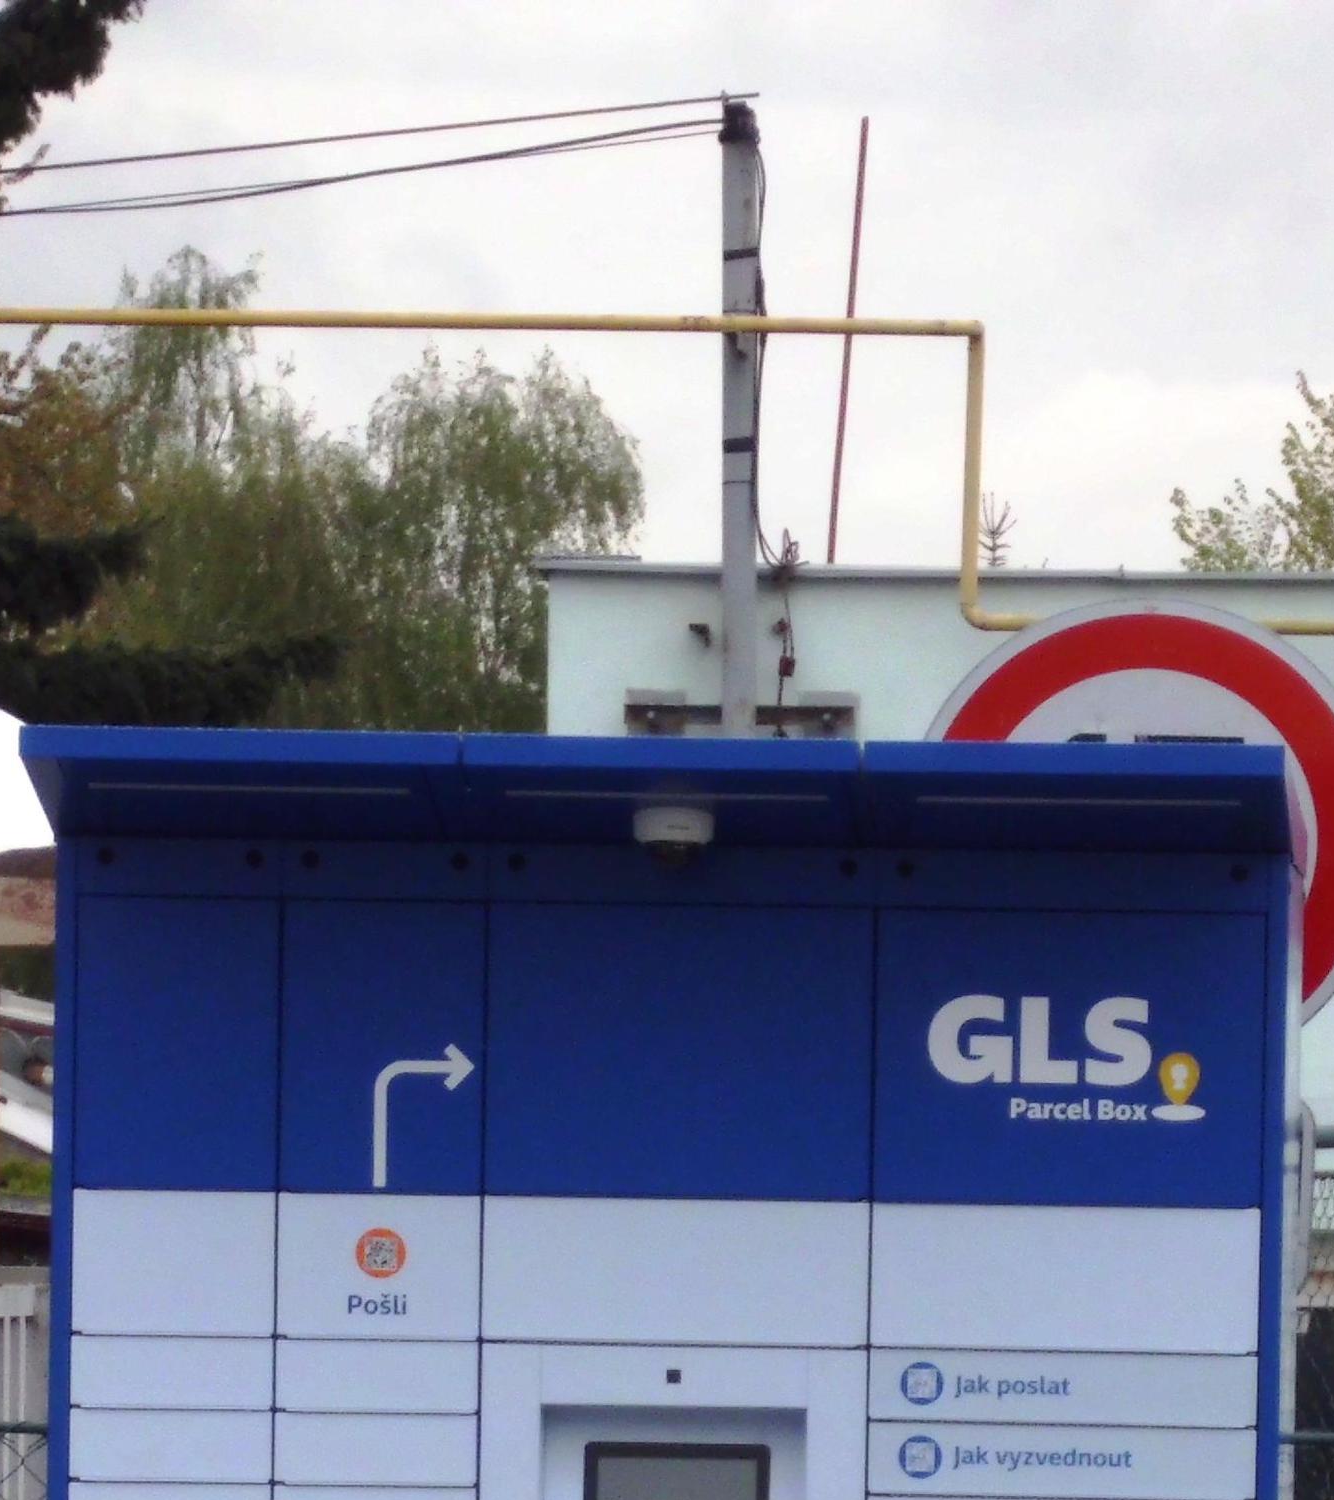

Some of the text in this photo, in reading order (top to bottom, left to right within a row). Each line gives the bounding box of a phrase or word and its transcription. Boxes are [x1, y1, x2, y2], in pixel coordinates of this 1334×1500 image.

[927, 994, 1152, 1086] GLS
[1010, 1098, 1148, 1121] Parcel Box
[347, 1292, 407, 1315] Pošli
[954, 1375, 1070, 1399] Jak poslat
[953, 1446, 1132, 1471] Jak vyzvednout
